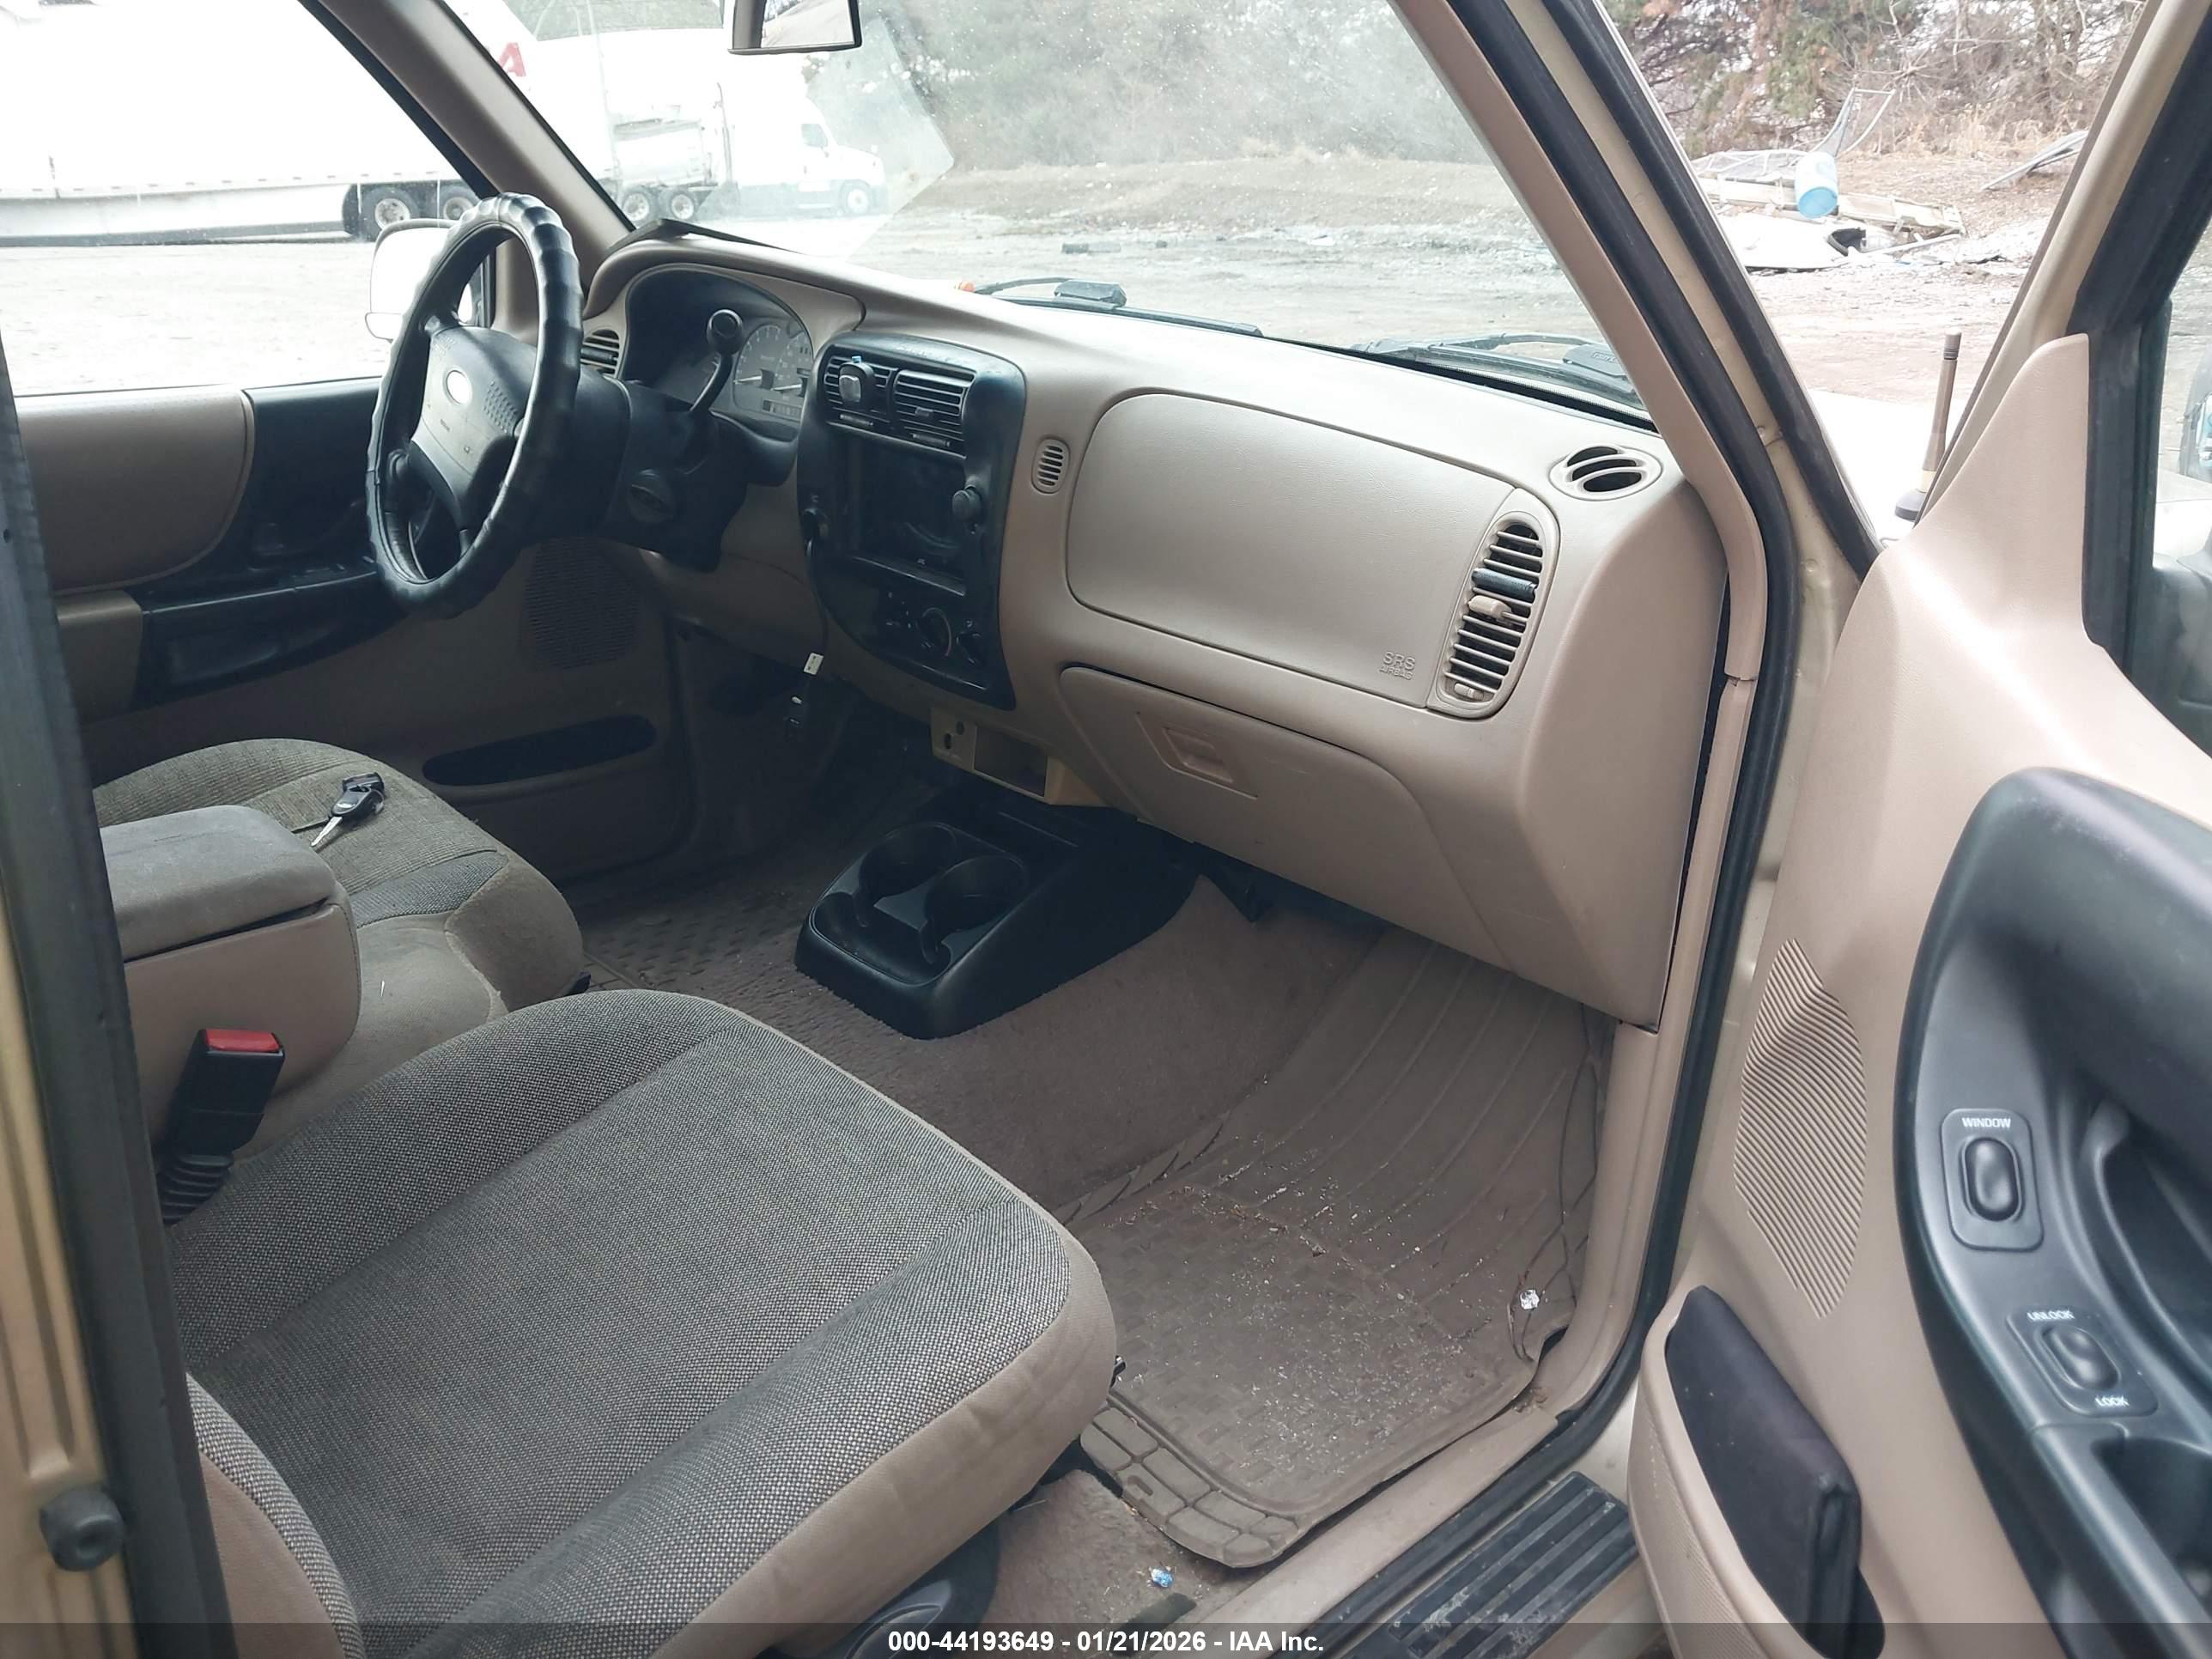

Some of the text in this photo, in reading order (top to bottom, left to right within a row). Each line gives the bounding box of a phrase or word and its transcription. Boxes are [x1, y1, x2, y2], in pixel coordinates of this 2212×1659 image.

[1383, 651, 1416, 671] SRS
[1379, 665, 1413, 681] AIRBAG
[1961, 1117, 2011, 1128] WINDOW
[2027, 1309, 2075, 1322] UNLOCK
[2095, 1395, 2130, 1407] LOCK
